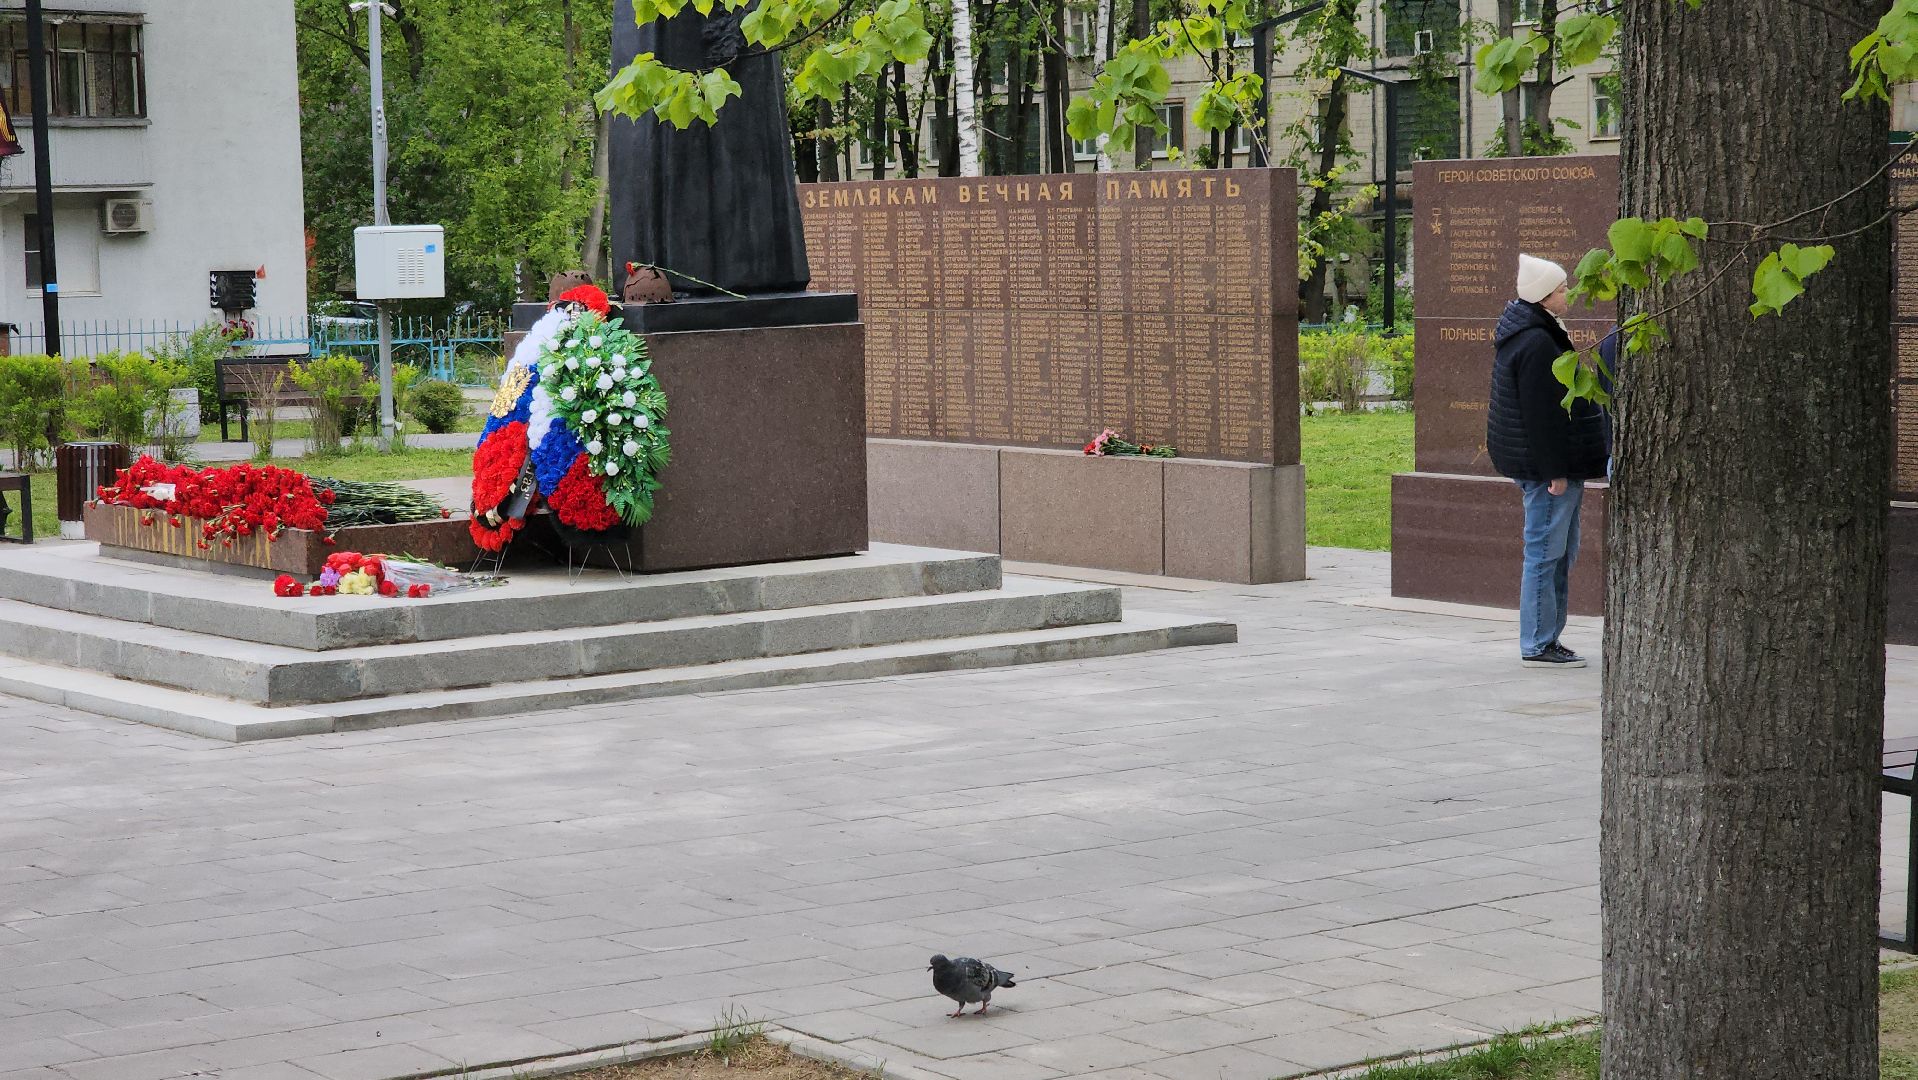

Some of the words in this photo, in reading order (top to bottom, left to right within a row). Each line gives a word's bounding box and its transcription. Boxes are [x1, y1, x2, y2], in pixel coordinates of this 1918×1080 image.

[1438, 170, 1474, 183] ГЕРОИ
[1476, 167, 1550, 182] СОВЕТСКОГО
[1552, 166, 1596, 180] СОЮЗА
[805, 186, 937, 209] ЗЕМЛЯКАМ
[959, 181, 1073, 203] ВЕЧНАЯ
[1106, 176, 1241, 200] ПАМЯТЬ
[1440, 327, 1487, 341] ПОЛНЫЕ
